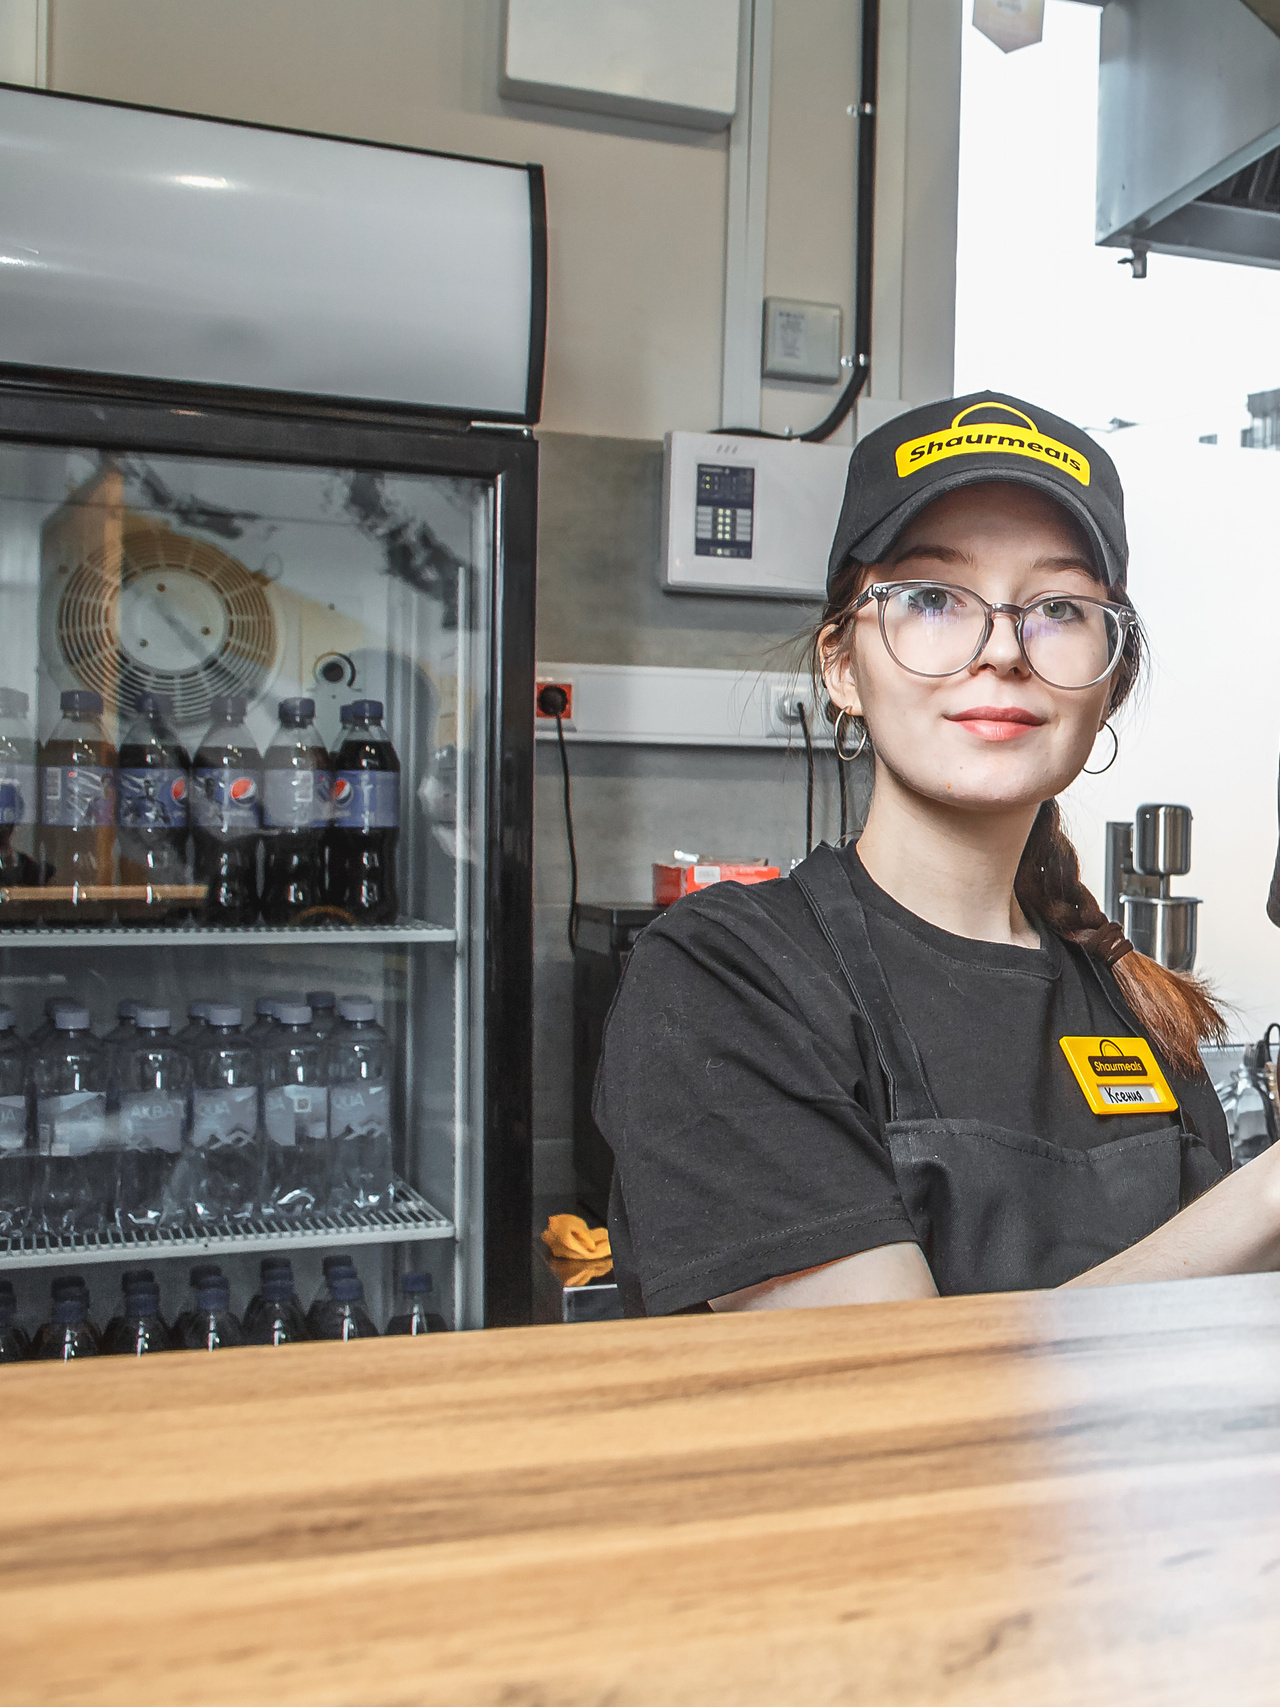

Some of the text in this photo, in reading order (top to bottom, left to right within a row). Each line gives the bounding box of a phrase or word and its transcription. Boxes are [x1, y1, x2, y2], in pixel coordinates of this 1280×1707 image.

[909, 433, 1081, 472] Shaurmeals
[1093, 1060, 1143, 1072] Shaurmeals
[1104, 1087, 1144, 1104] Ксения
